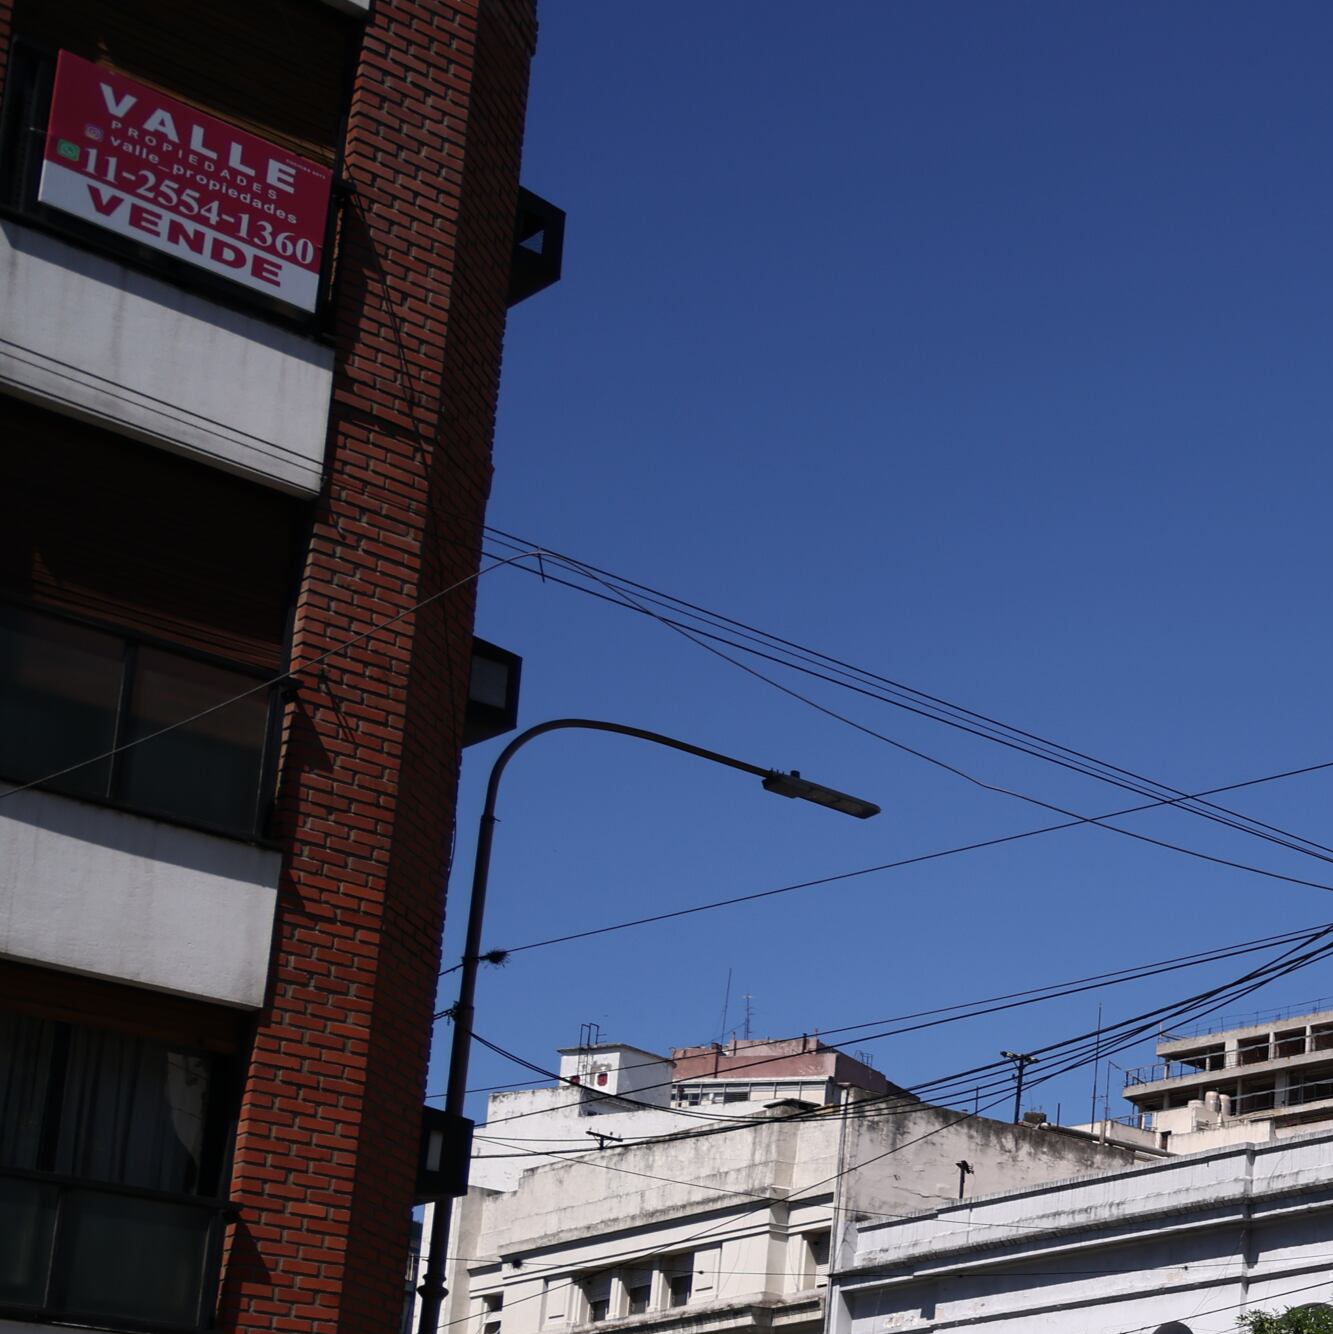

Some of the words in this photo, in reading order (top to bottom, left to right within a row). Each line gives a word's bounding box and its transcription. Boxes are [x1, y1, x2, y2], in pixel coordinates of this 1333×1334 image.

[100, 82, 296, 194] VALLE
[110, 136, 297, 224] valle_propiedades
[111, 120, 278, 199] PROPIEDADES
[84, 148, 314, 265] 11-2554-1360
[87, 183, 283, 288] VENDE
